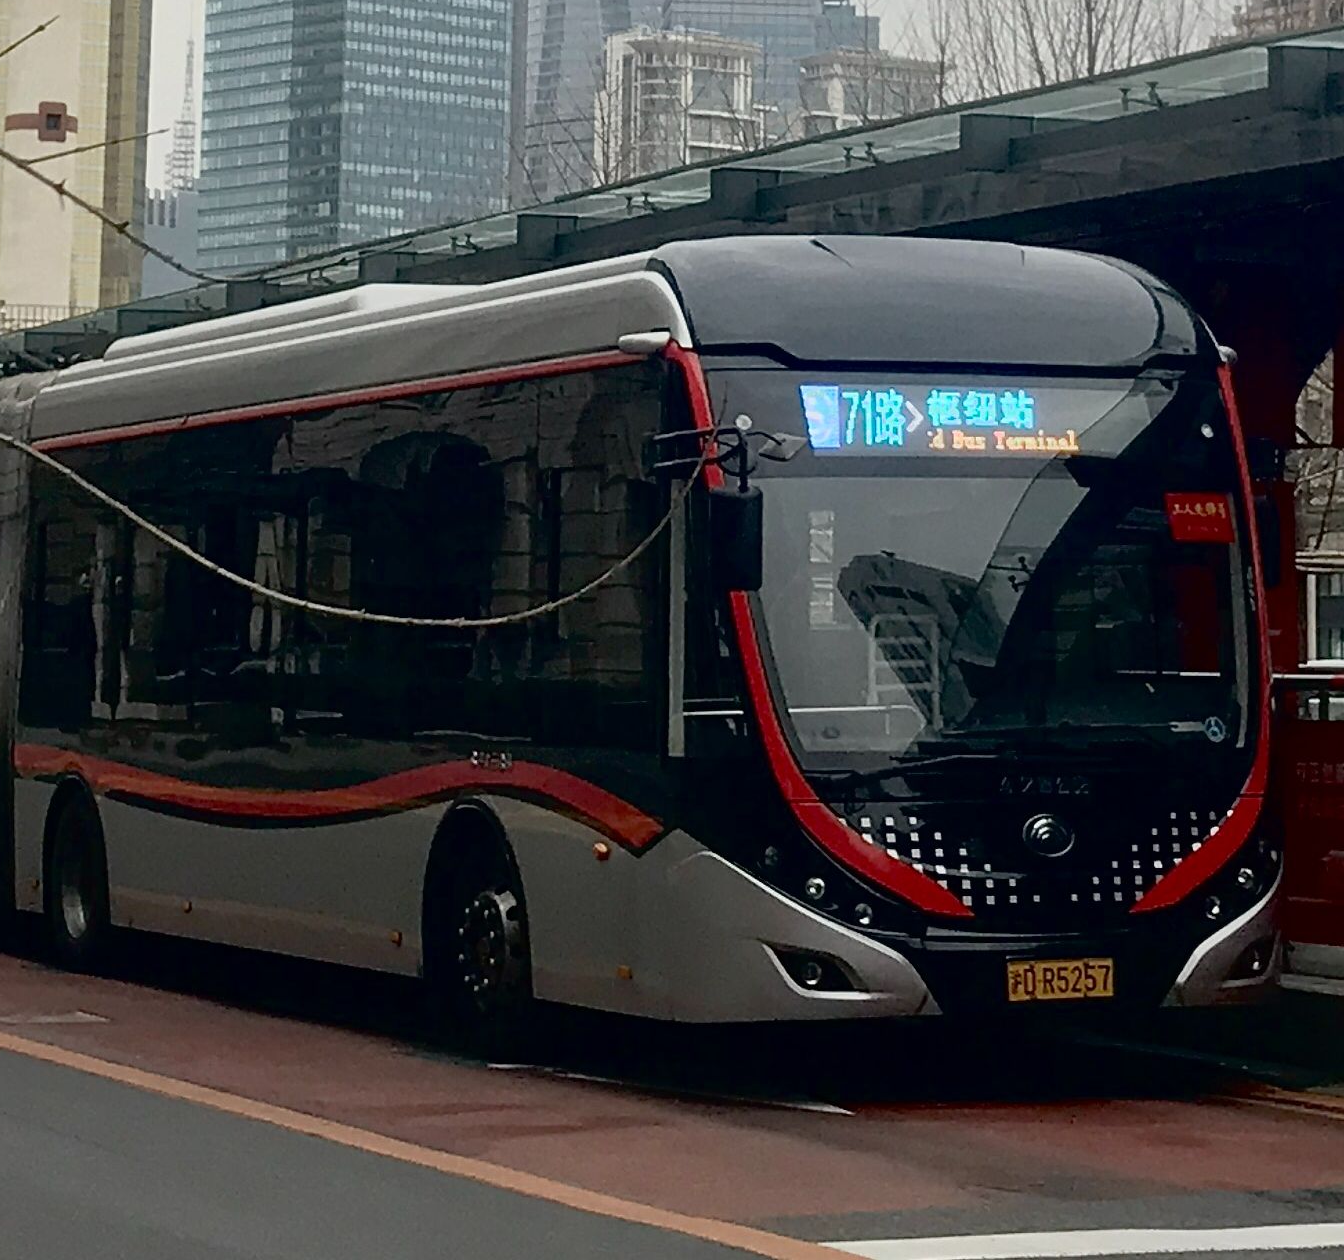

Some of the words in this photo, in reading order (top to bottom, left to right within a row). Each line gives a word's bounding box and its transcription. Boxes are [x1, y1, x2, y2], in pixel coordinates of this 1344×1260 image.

[841, 388, 906, 446] 71路
[926, 388, 1035, 429] 枢纽站
[951, 429, 986, 451] Bus
[993, 429, 1079, 452] Terminal
